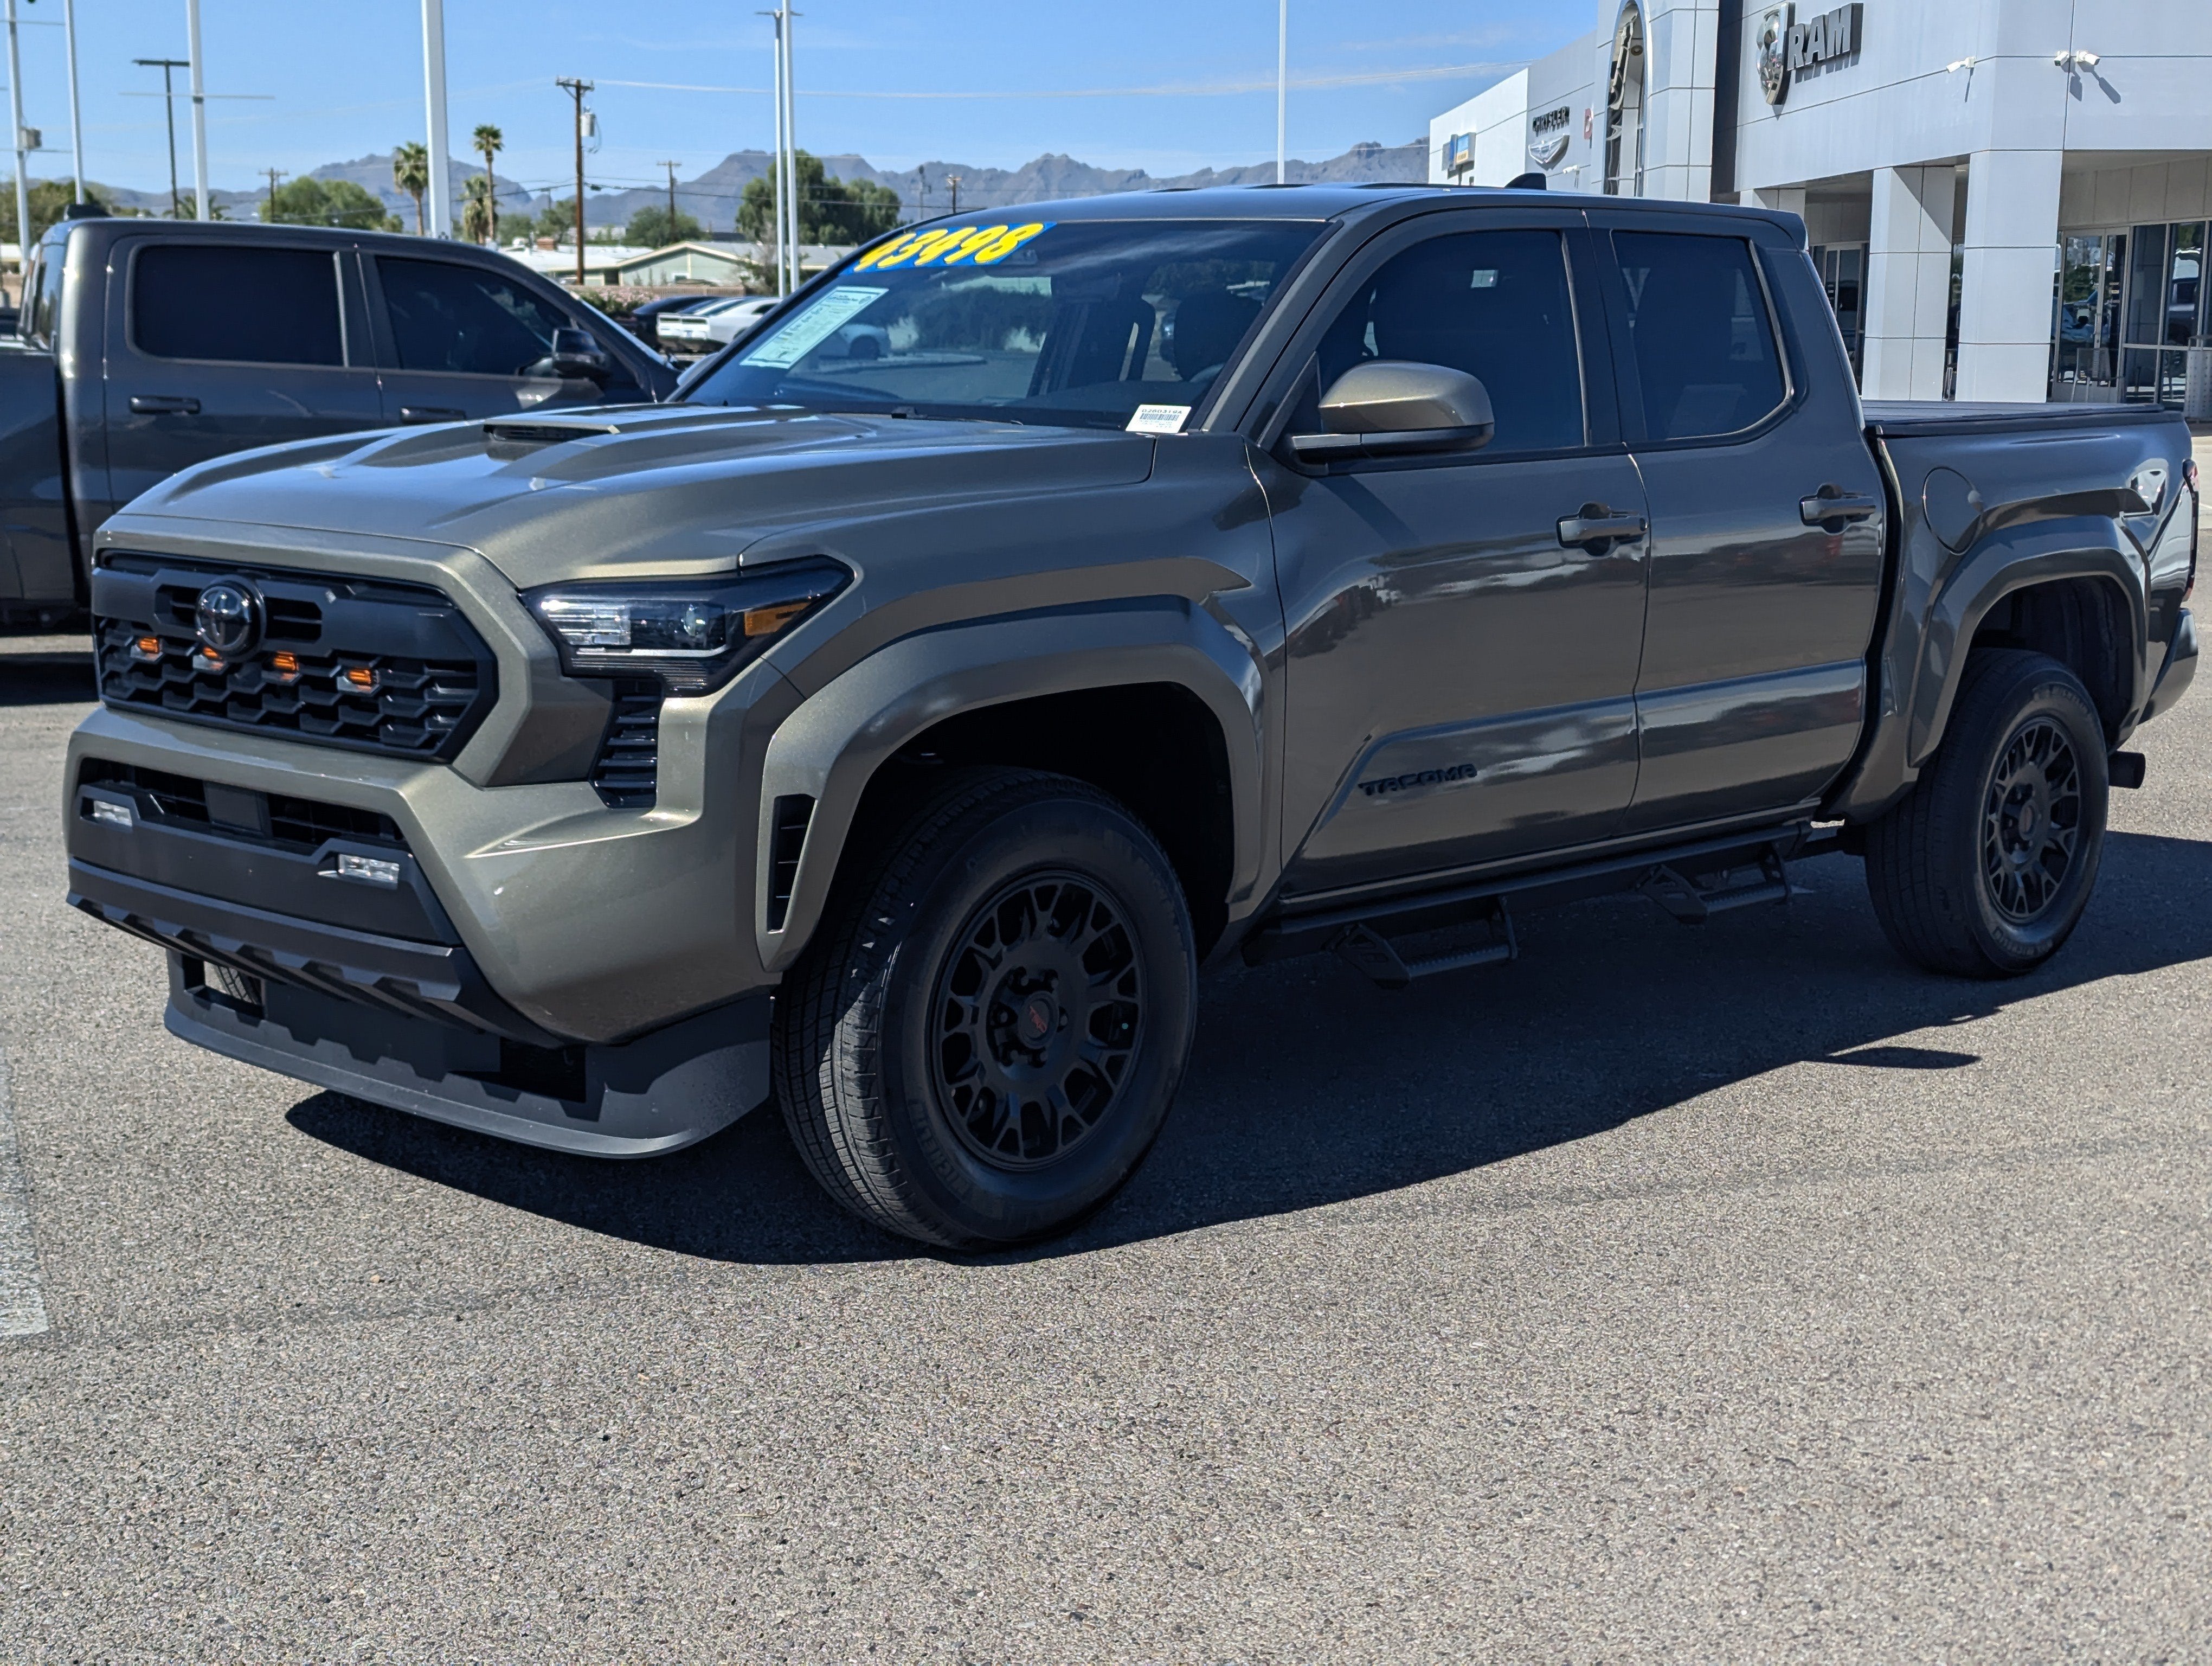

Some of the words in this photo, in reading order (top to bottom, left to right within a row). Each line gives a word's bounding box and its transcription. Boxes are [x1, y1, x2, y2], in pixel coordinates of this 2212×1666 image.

[1787, 3, 1863, 71] RAM
[853, 222, 1044, 272] 43498
[1358, 763, 1478, 796] TACOMA
